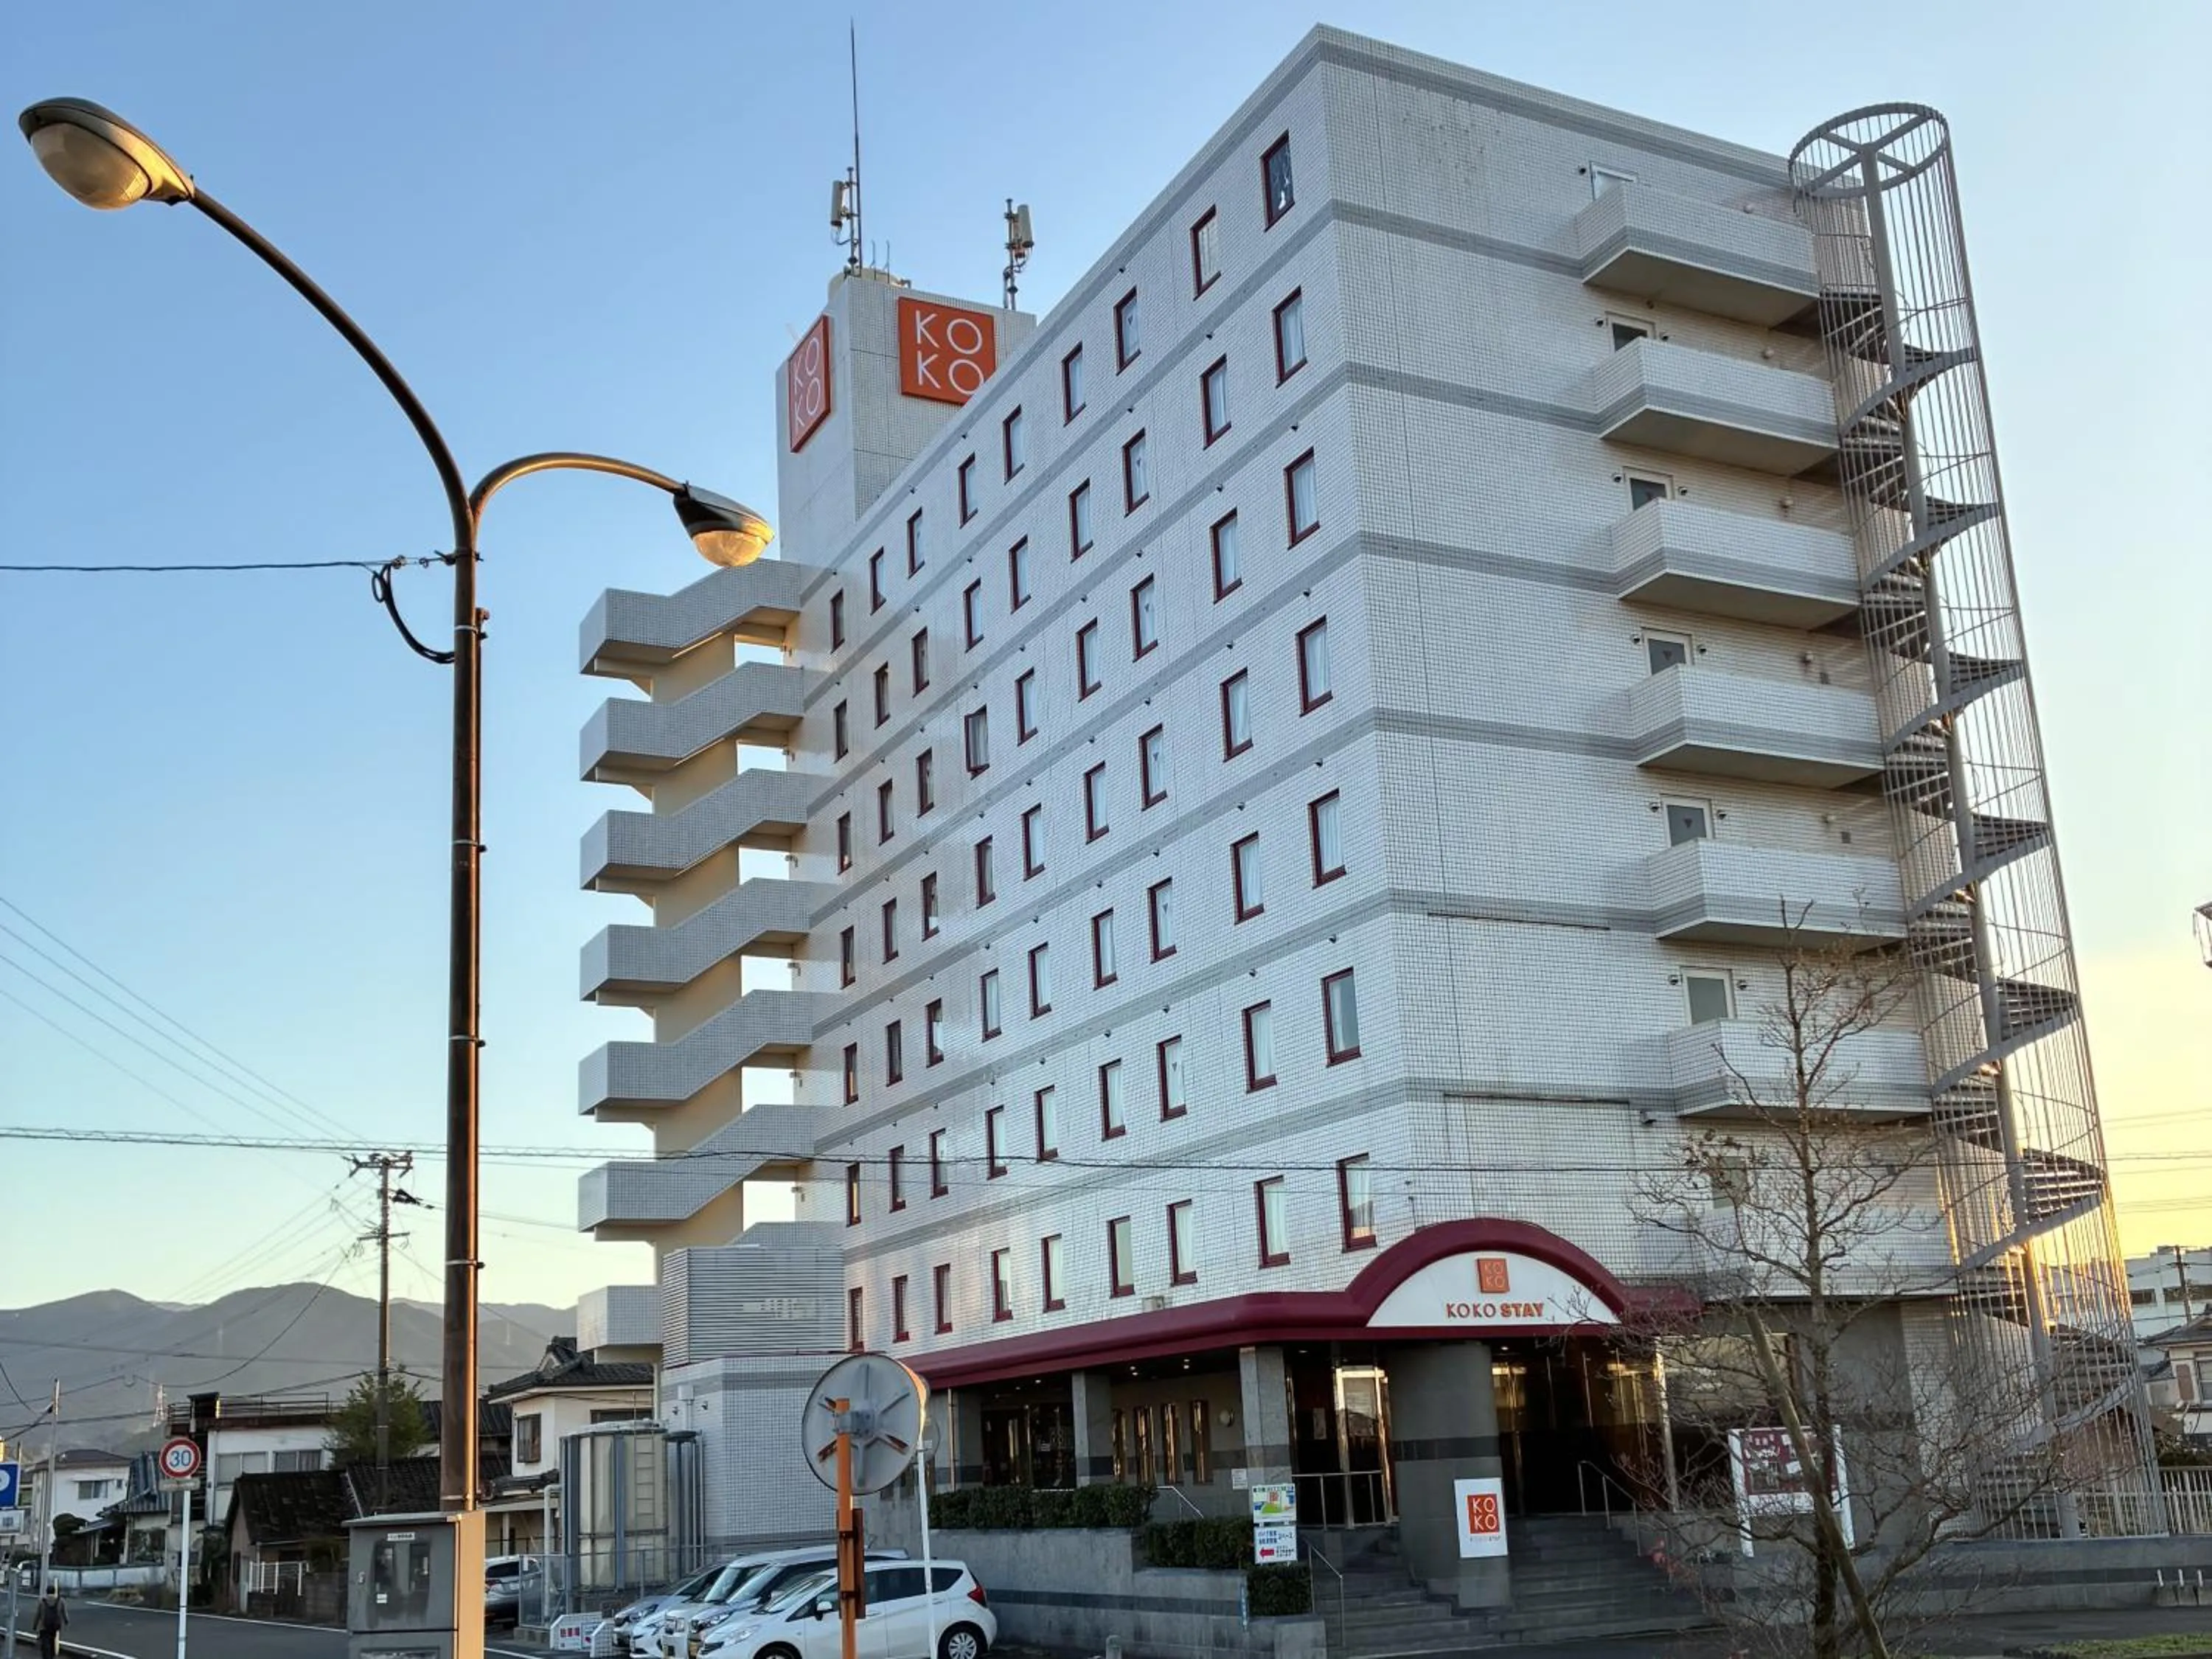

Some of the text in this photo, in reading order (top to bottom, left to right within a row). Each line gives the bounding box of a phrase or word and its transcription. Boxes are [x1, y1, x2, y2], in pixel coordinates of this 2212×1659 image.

[915, 310, 983, 355] KO
[793, 337, 820, 389] KO
[917, 350, 984, 395] KO
[794, 377, 821, 428] KO
[1484, 1262, 1503, 1275] KO
[1486, 1275, 1505, 1287] KO
[1446, 1302, 1545, 1318] KOKO STAY
[170, 1450, 192, 1467] 30
[1472, 1497, 1496, 1513] KO
[1474, 1514, 1498, 1531] KO
